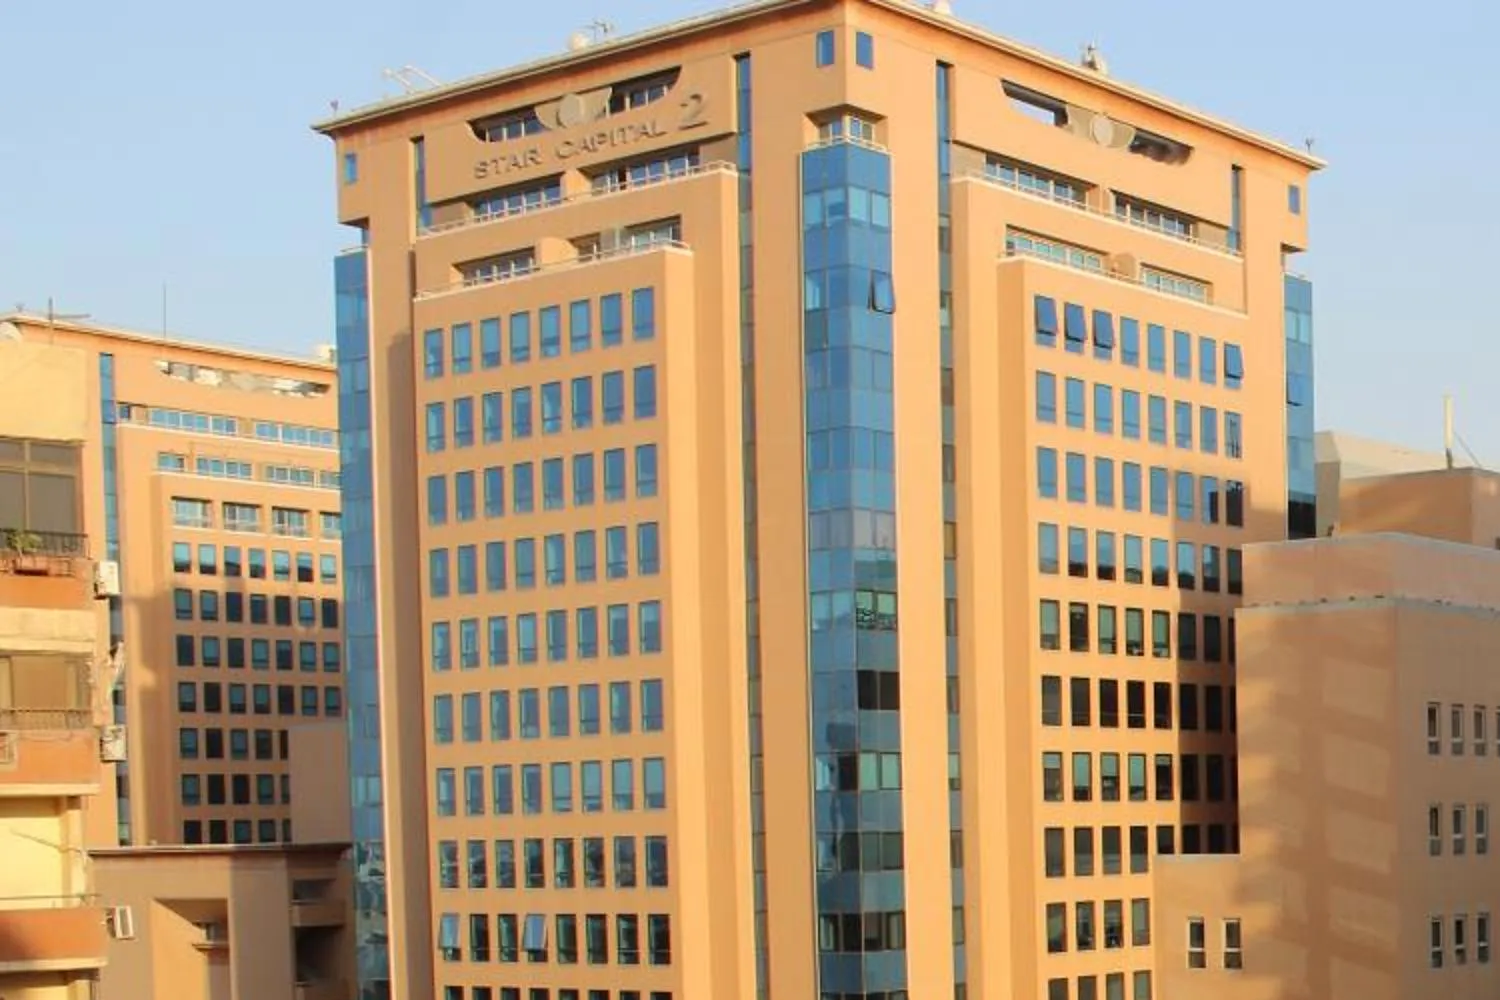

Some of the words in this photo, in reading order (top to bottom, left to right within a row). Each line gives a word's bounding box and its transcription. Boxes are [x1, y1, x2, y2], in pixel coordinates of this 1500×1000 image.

[474, 148, 542, 179] STAR
[556, 121, 667, 158] CAPITAL
[679, 93, 709, 130] 2
